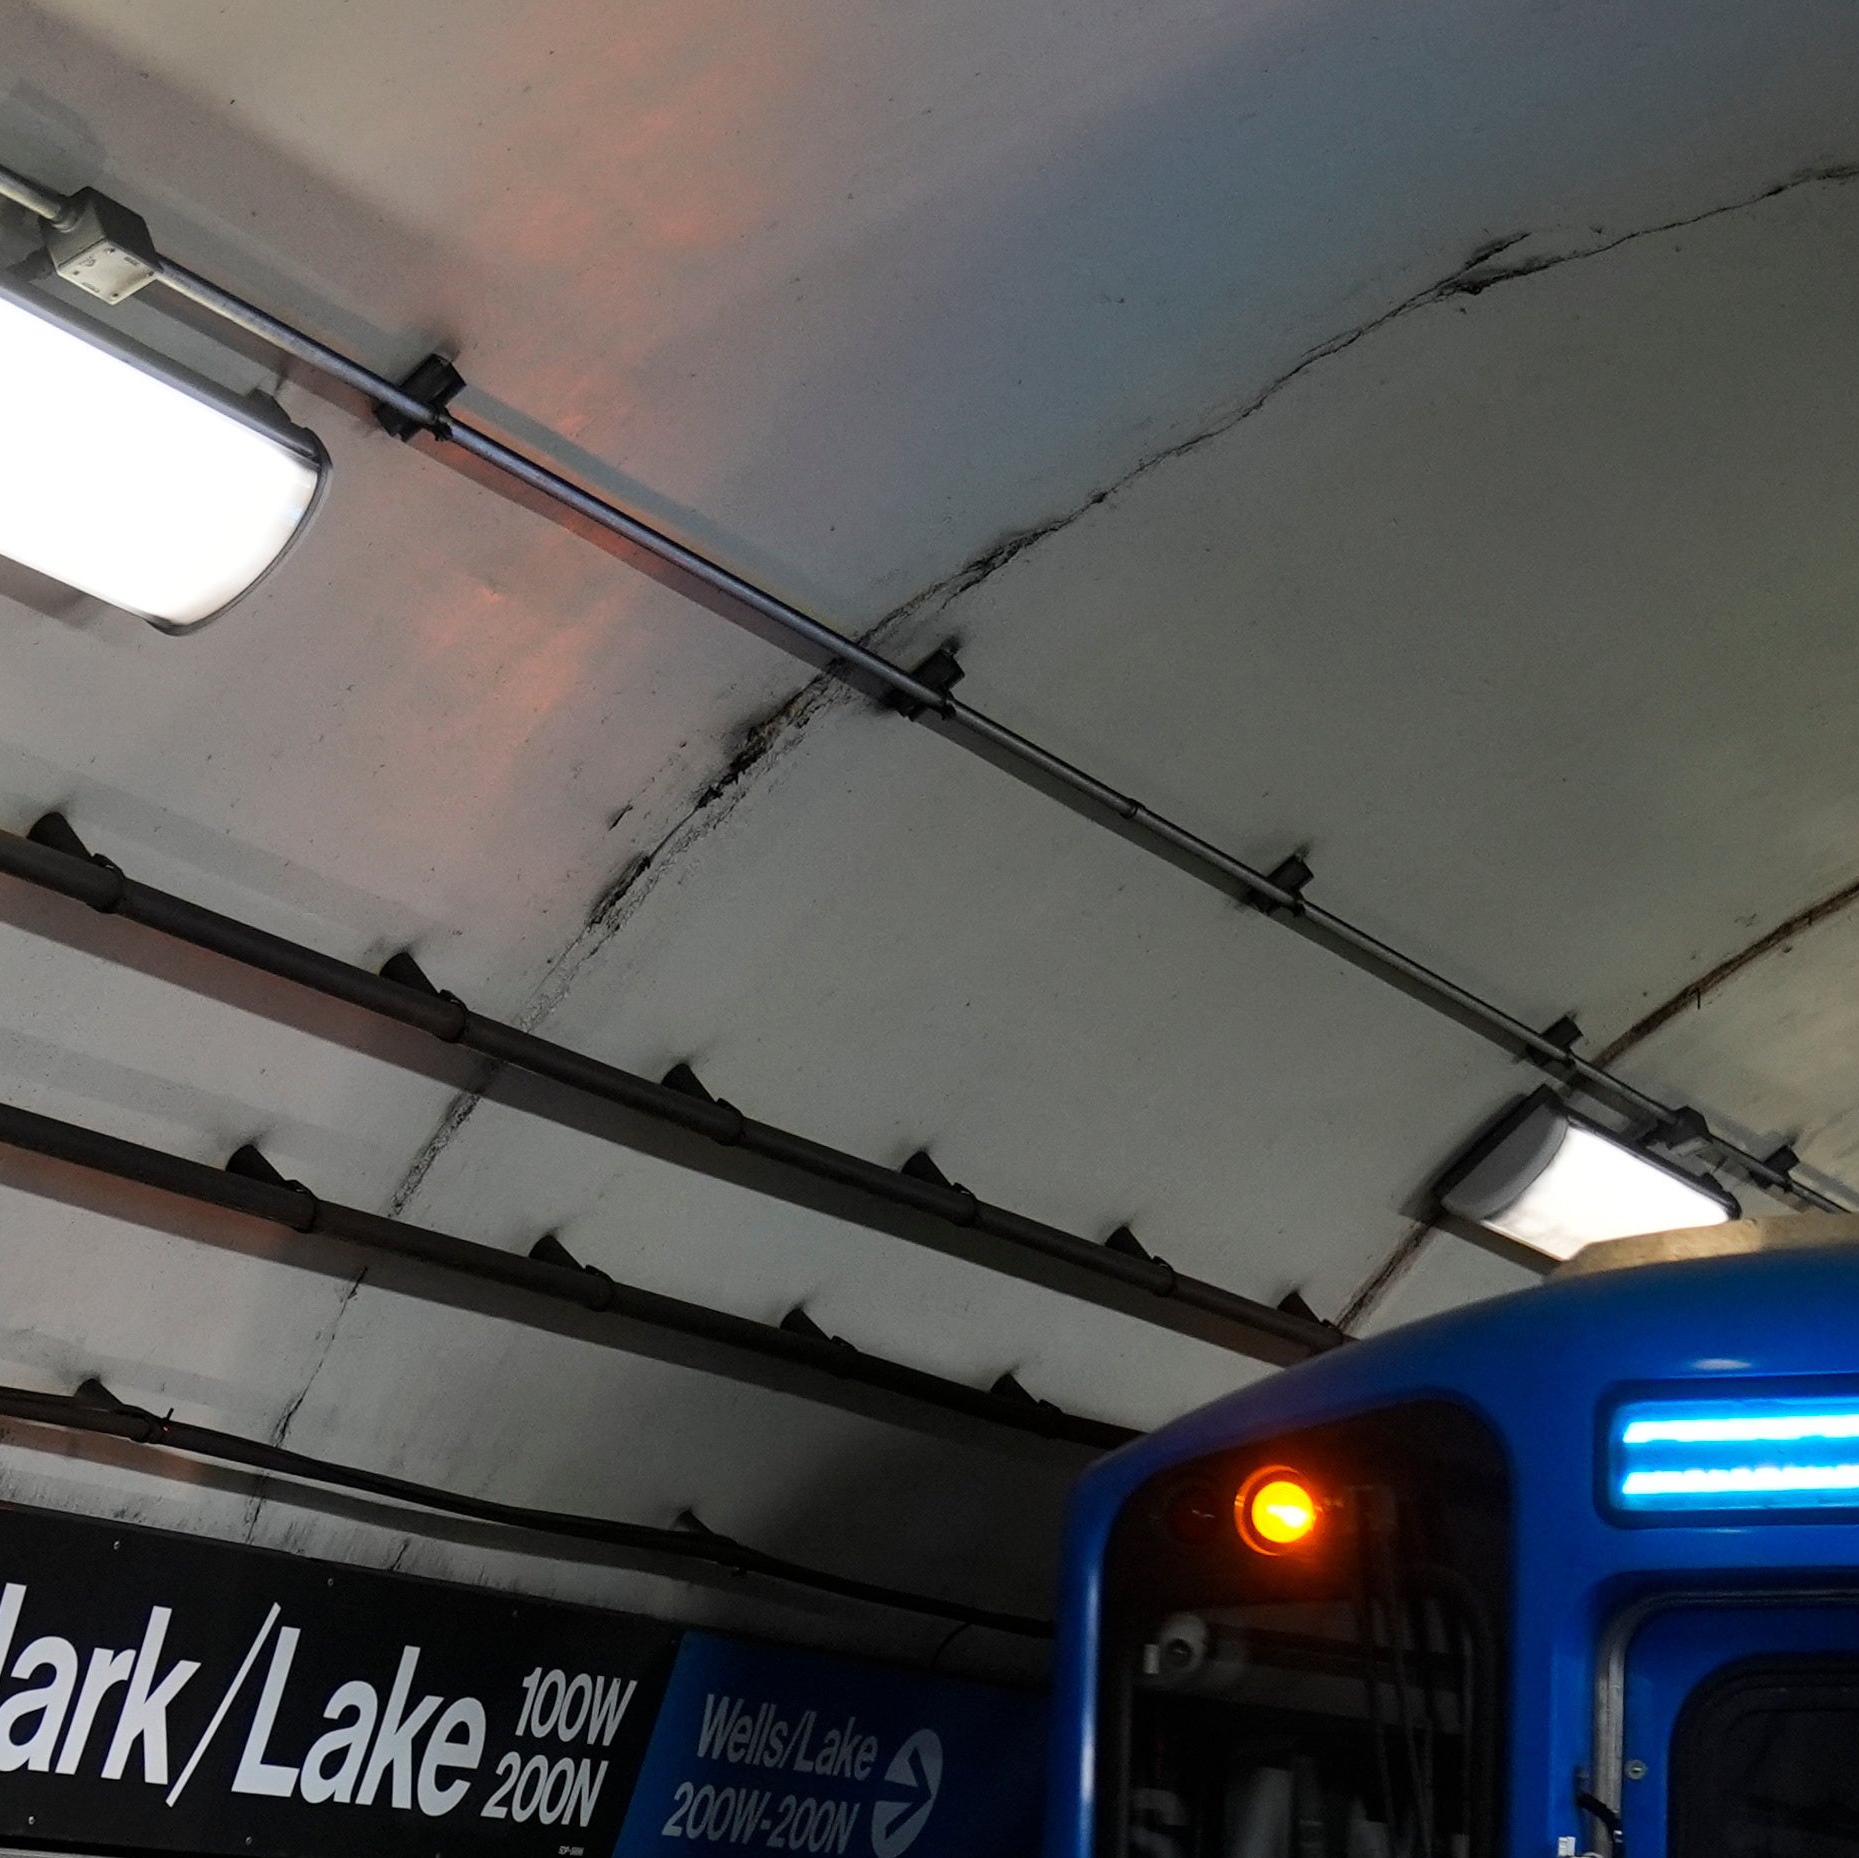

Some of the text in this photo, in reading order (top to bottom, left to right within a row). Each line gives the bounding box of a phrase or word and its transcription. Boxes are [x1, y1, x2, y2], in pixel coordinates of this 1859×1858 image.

[516, 1666, 636, 1750] 100W
[697, 1693, 878, 1781] Wells/Lake
[481, 1750, 608, 1828] 200N
[661, 1780, 861, 1855] 200W-200N
